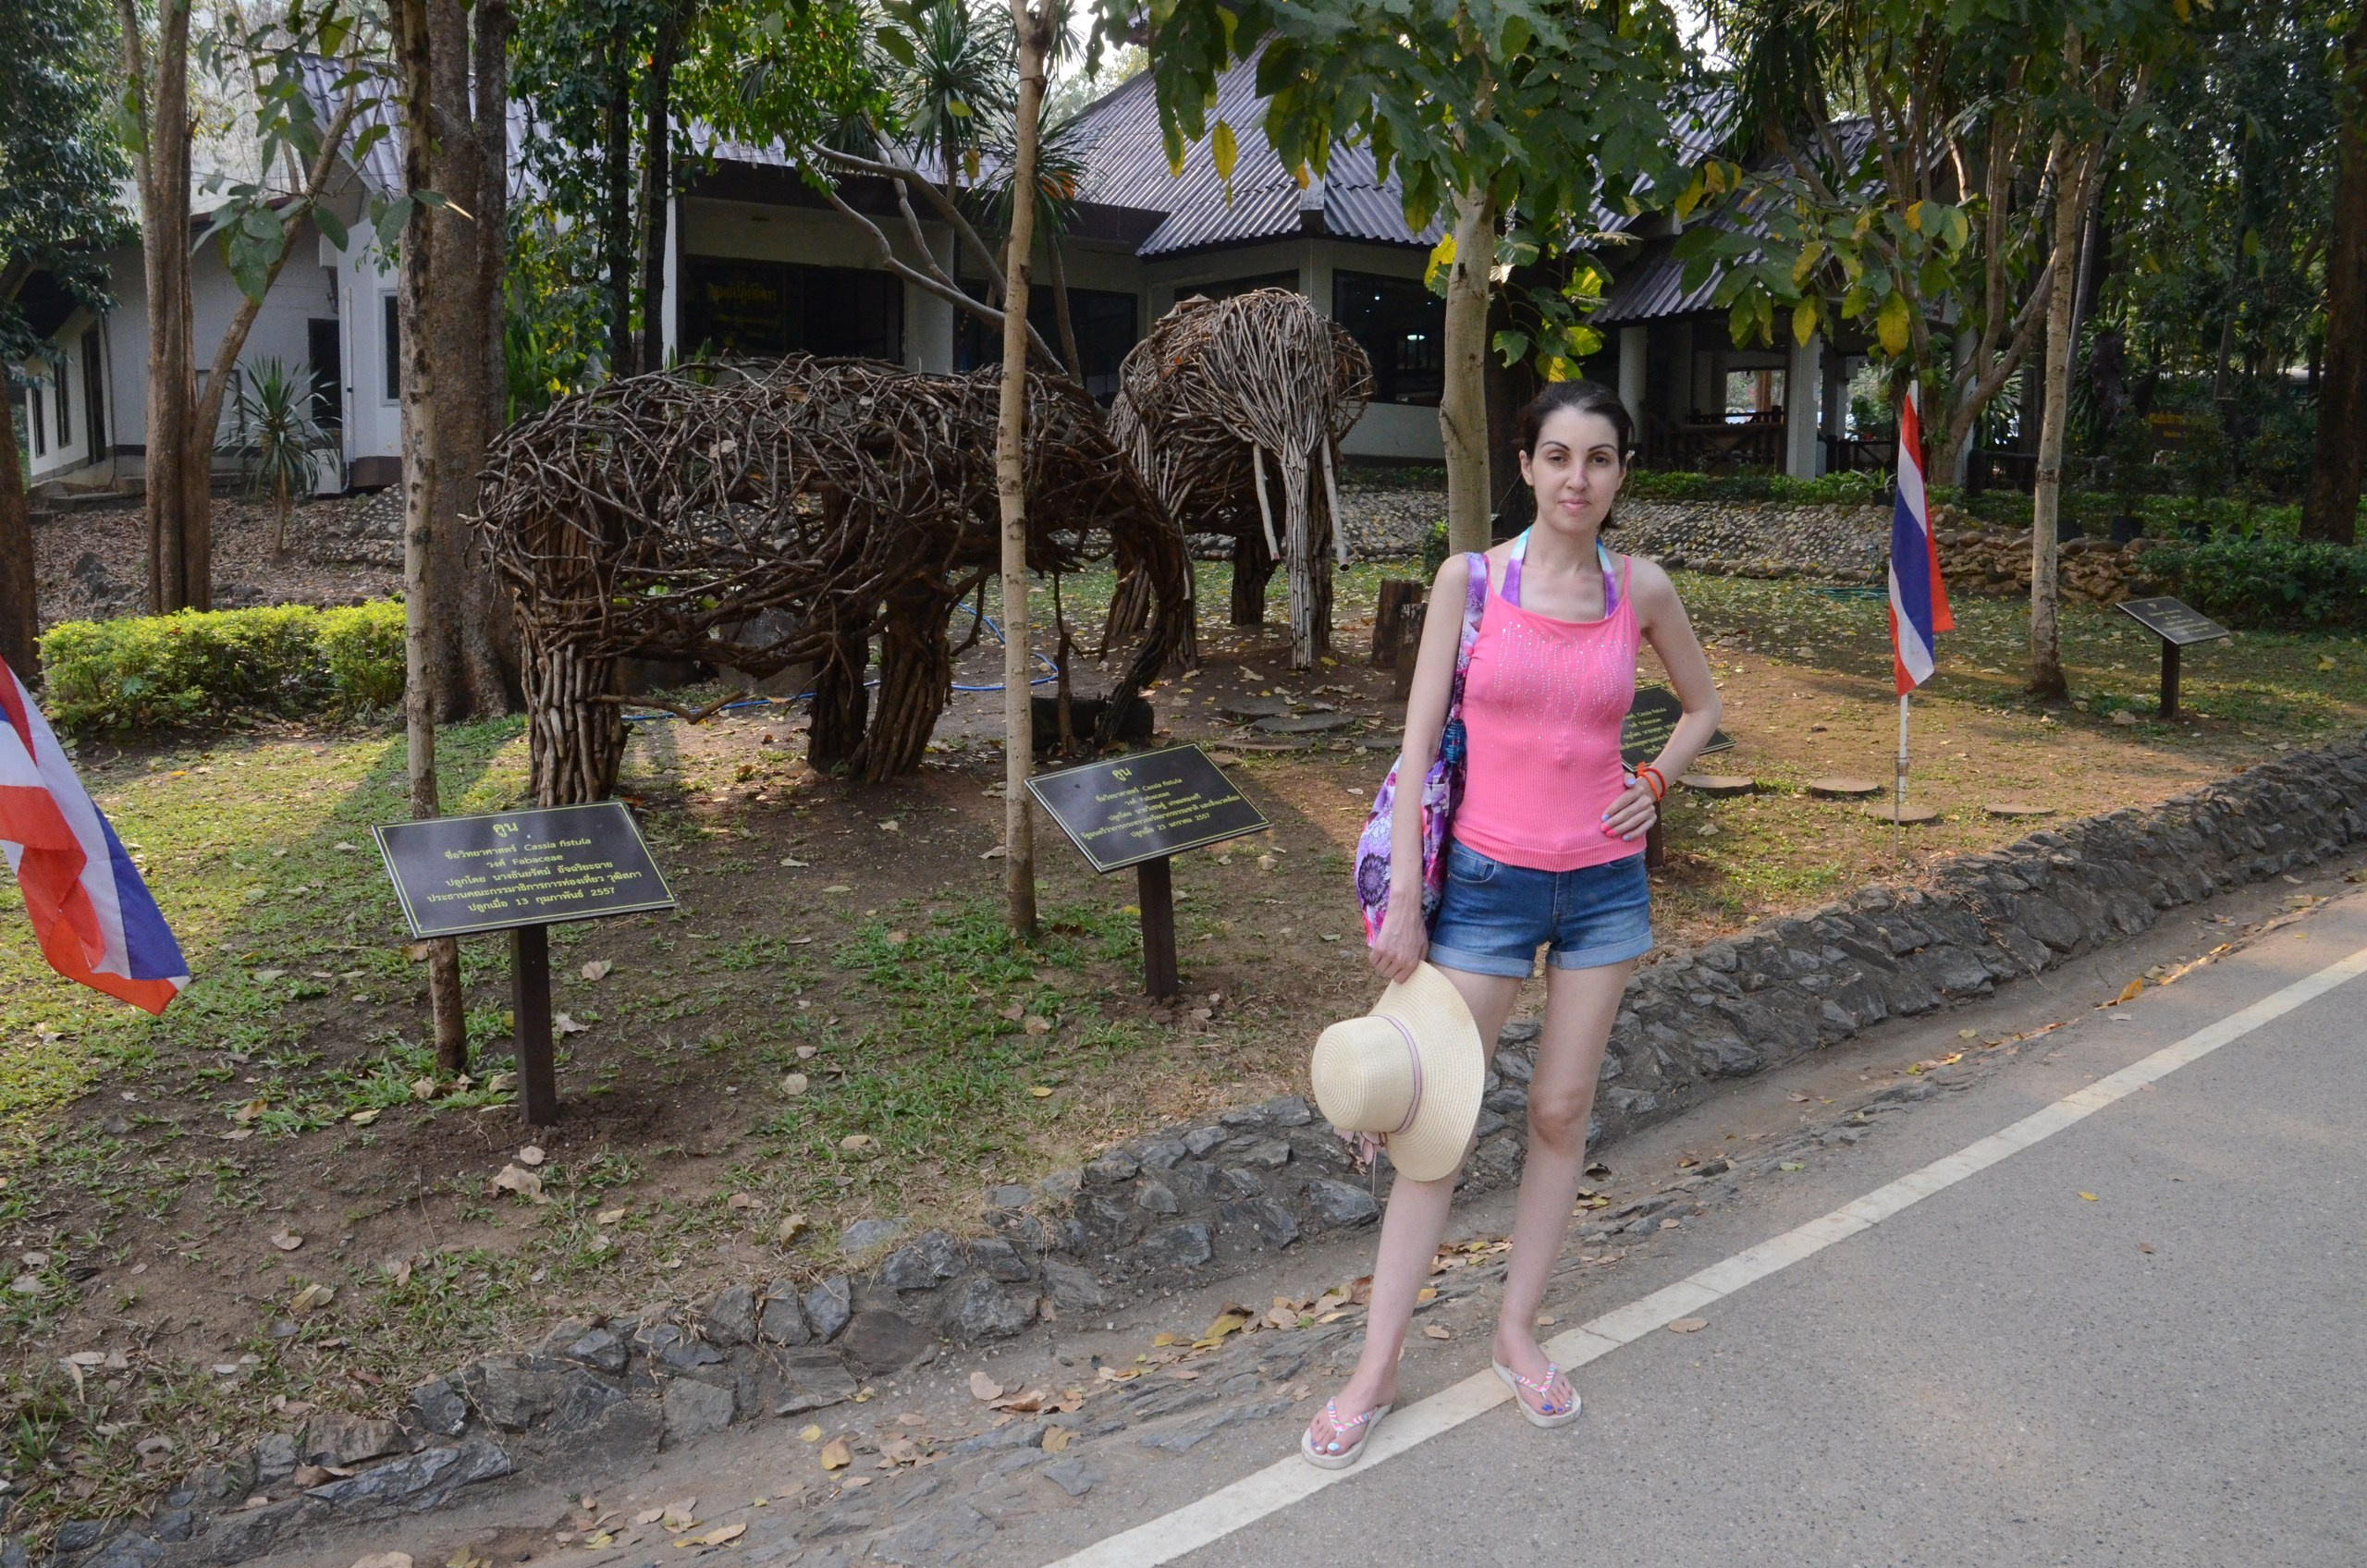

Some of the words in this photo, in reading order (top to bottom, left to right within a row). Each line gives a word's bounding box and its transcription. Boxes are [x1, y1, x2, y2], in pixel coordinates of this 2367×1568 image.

[1111, 767, 1133, 782] คูน
[1142, 783, 1162, 791] Cassia
[1162, 778, 1184, 787] fistula
[1194, 812, 1210, 821] 2557
[492, 822, 519, 838] คูน
[444, 844, 517, 860] ชื่อวิทยาศาสตร์
[523, 841, 557, 851] Cassia
[559, 838, 592, 848] fistula
[485, 858, 507, 868] วงศ์
[511, 853, 564, 865] Fabaceae
[426, 874, 605, 903] ประธานคณะกรรมาธิการการท่องเที่ยว
[607, 870, 643, 884] วุฒิสภา
[446, 875, 486, 888] ปลูกโดย
[467, 898, 509, 913] ปลูกเมื่อ
[515, 897, 529, 906] 13
[535, 888, 584, 905] กุมภาพันธ์
[590, 887, 615, 897] 2557
